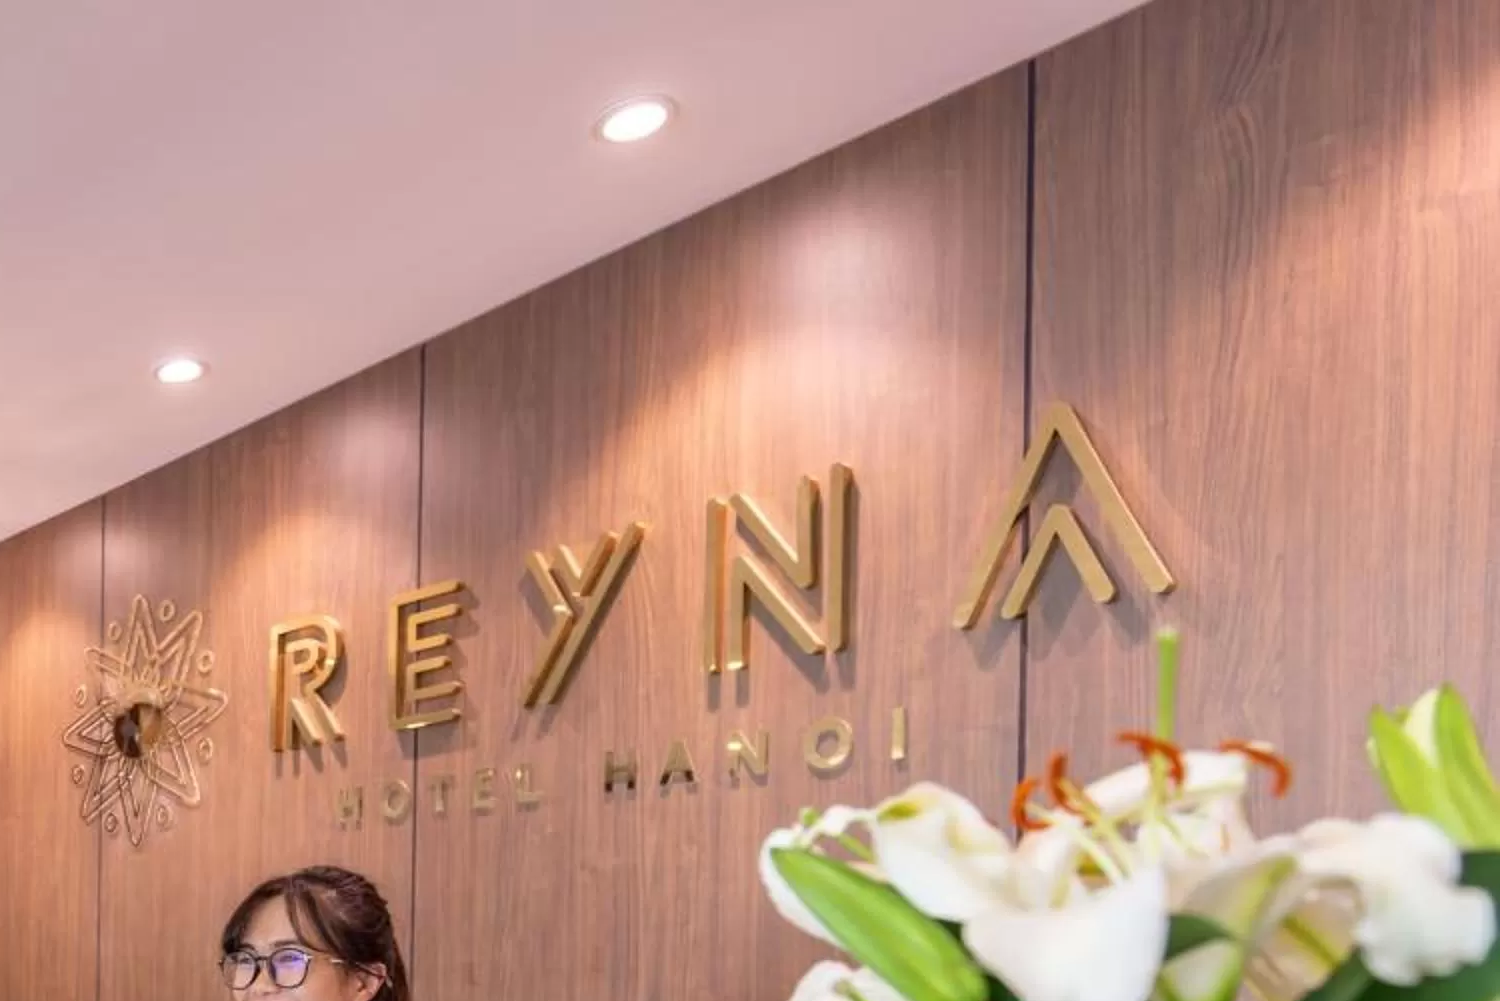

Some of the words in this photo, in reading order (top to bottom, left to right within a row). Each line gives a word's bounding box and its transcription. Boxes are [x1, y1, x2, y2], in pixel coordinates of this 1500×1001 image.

[268, 402, 1177, 752] REYNA
[337, 761, 543, 826] HOTEL
[604, 707, 908, 793] HANOI
